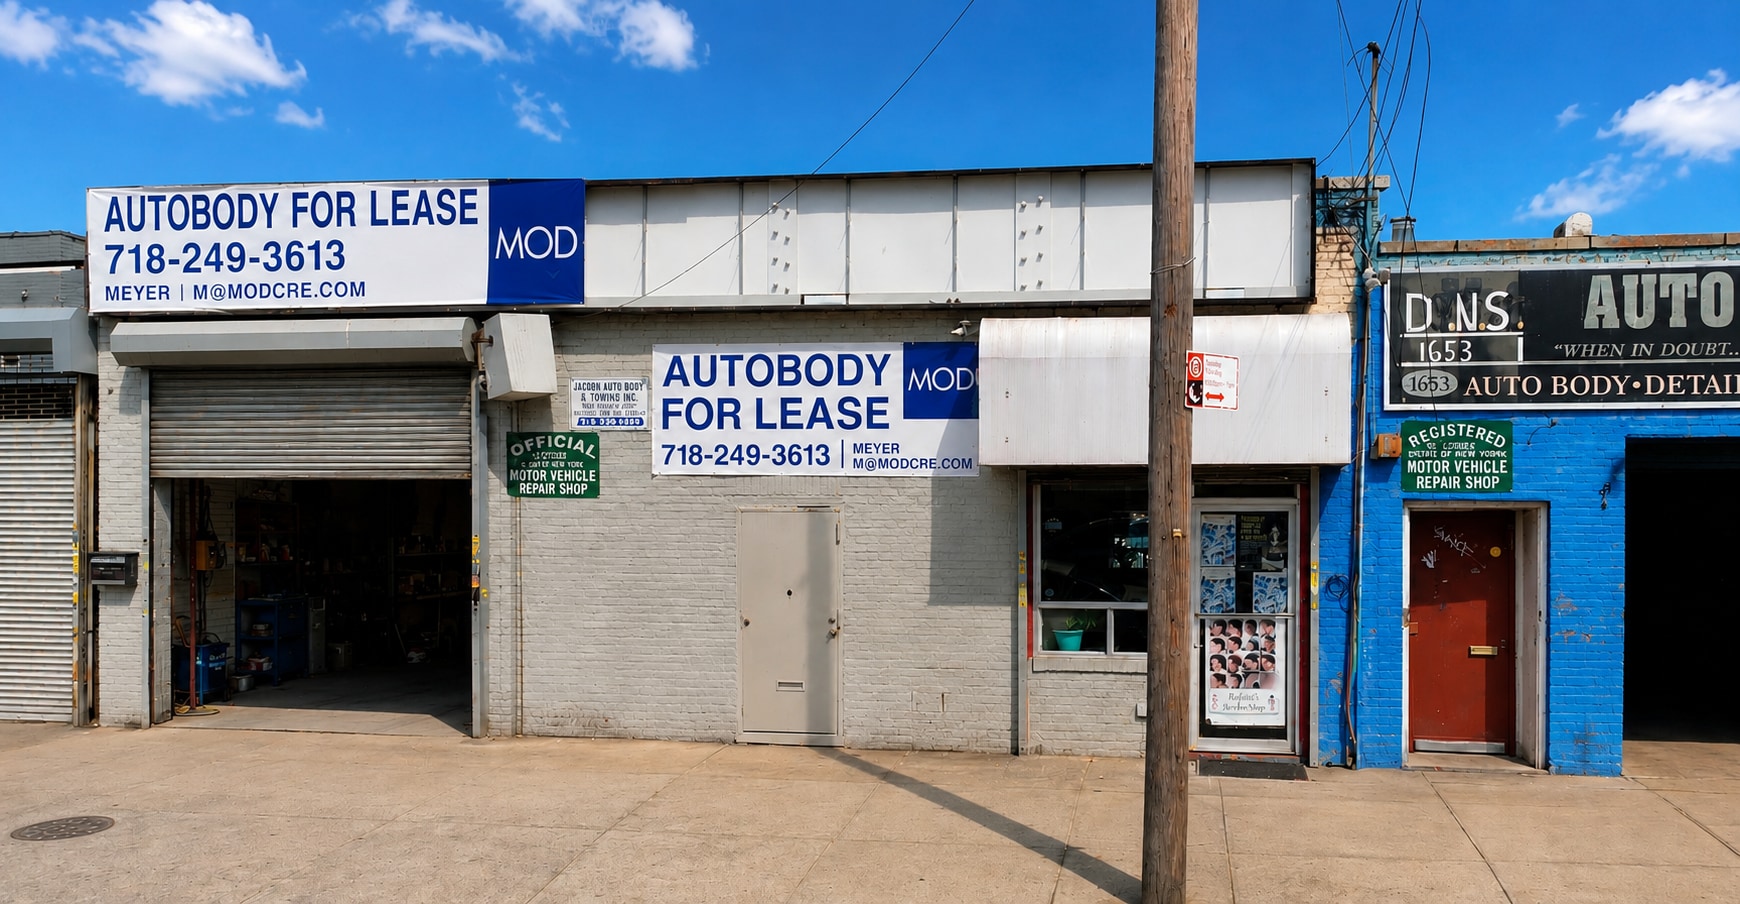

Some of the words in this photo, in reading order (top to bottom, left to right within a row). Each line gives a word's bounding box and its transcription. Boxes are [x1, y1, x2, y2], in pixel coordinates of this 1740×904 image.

[105, 193, 278, 232] AUTOBODY
[292, 190, 357, 228] FOR
[370, 188, 478, 226] LEASE
[496, 226, 577, 258] MOD
[105, 240, 344, 274] 718-249-3613
[106, 286, 169, 300] MEYER
[194, 282, 364, 301] M@MODCRE.COM
[1584, 271, 1734, 329] AUTO
[1420, 340, 1471, 361] 1653
[1631, 344, 1654, 356] IN
[663, 354, 891, 387] AUTOBODY
[603, 382, 622, 392] AUTO
[624, 382, 643, 392] BODY
[1409, 375, 1450, 392] 1653
[1464, 376, 1541, 395] AUTO
[1552, 376, 1630, 395] BODY
[663, 397, 741, 430] FOR
[756, 397, 889, 430] LEASE
[1409, 424, 1505, 449] REGISTERED
[510, 435, 596, 459] OFFICIAL
[662, 444, 830, 465] 718-249-3613
[854, 443, 899, 454] MEYER
[854, 458, 972, 471] M@MODCRE.COM
[1408, 460, 1449, 473] MOTOR
[1455, 460, 1507, 473] VEHICLE
[511, 470, 546, 481] MOTOR
[551, 470, 595, 481] VEHICLE
[1417, 476, 1460, 488] REPAIR
[1466, 476, 1499, 488] SHOP
[520, 483, 555, 494] REPAIR
[560, 483, 587, 494] SHOP
